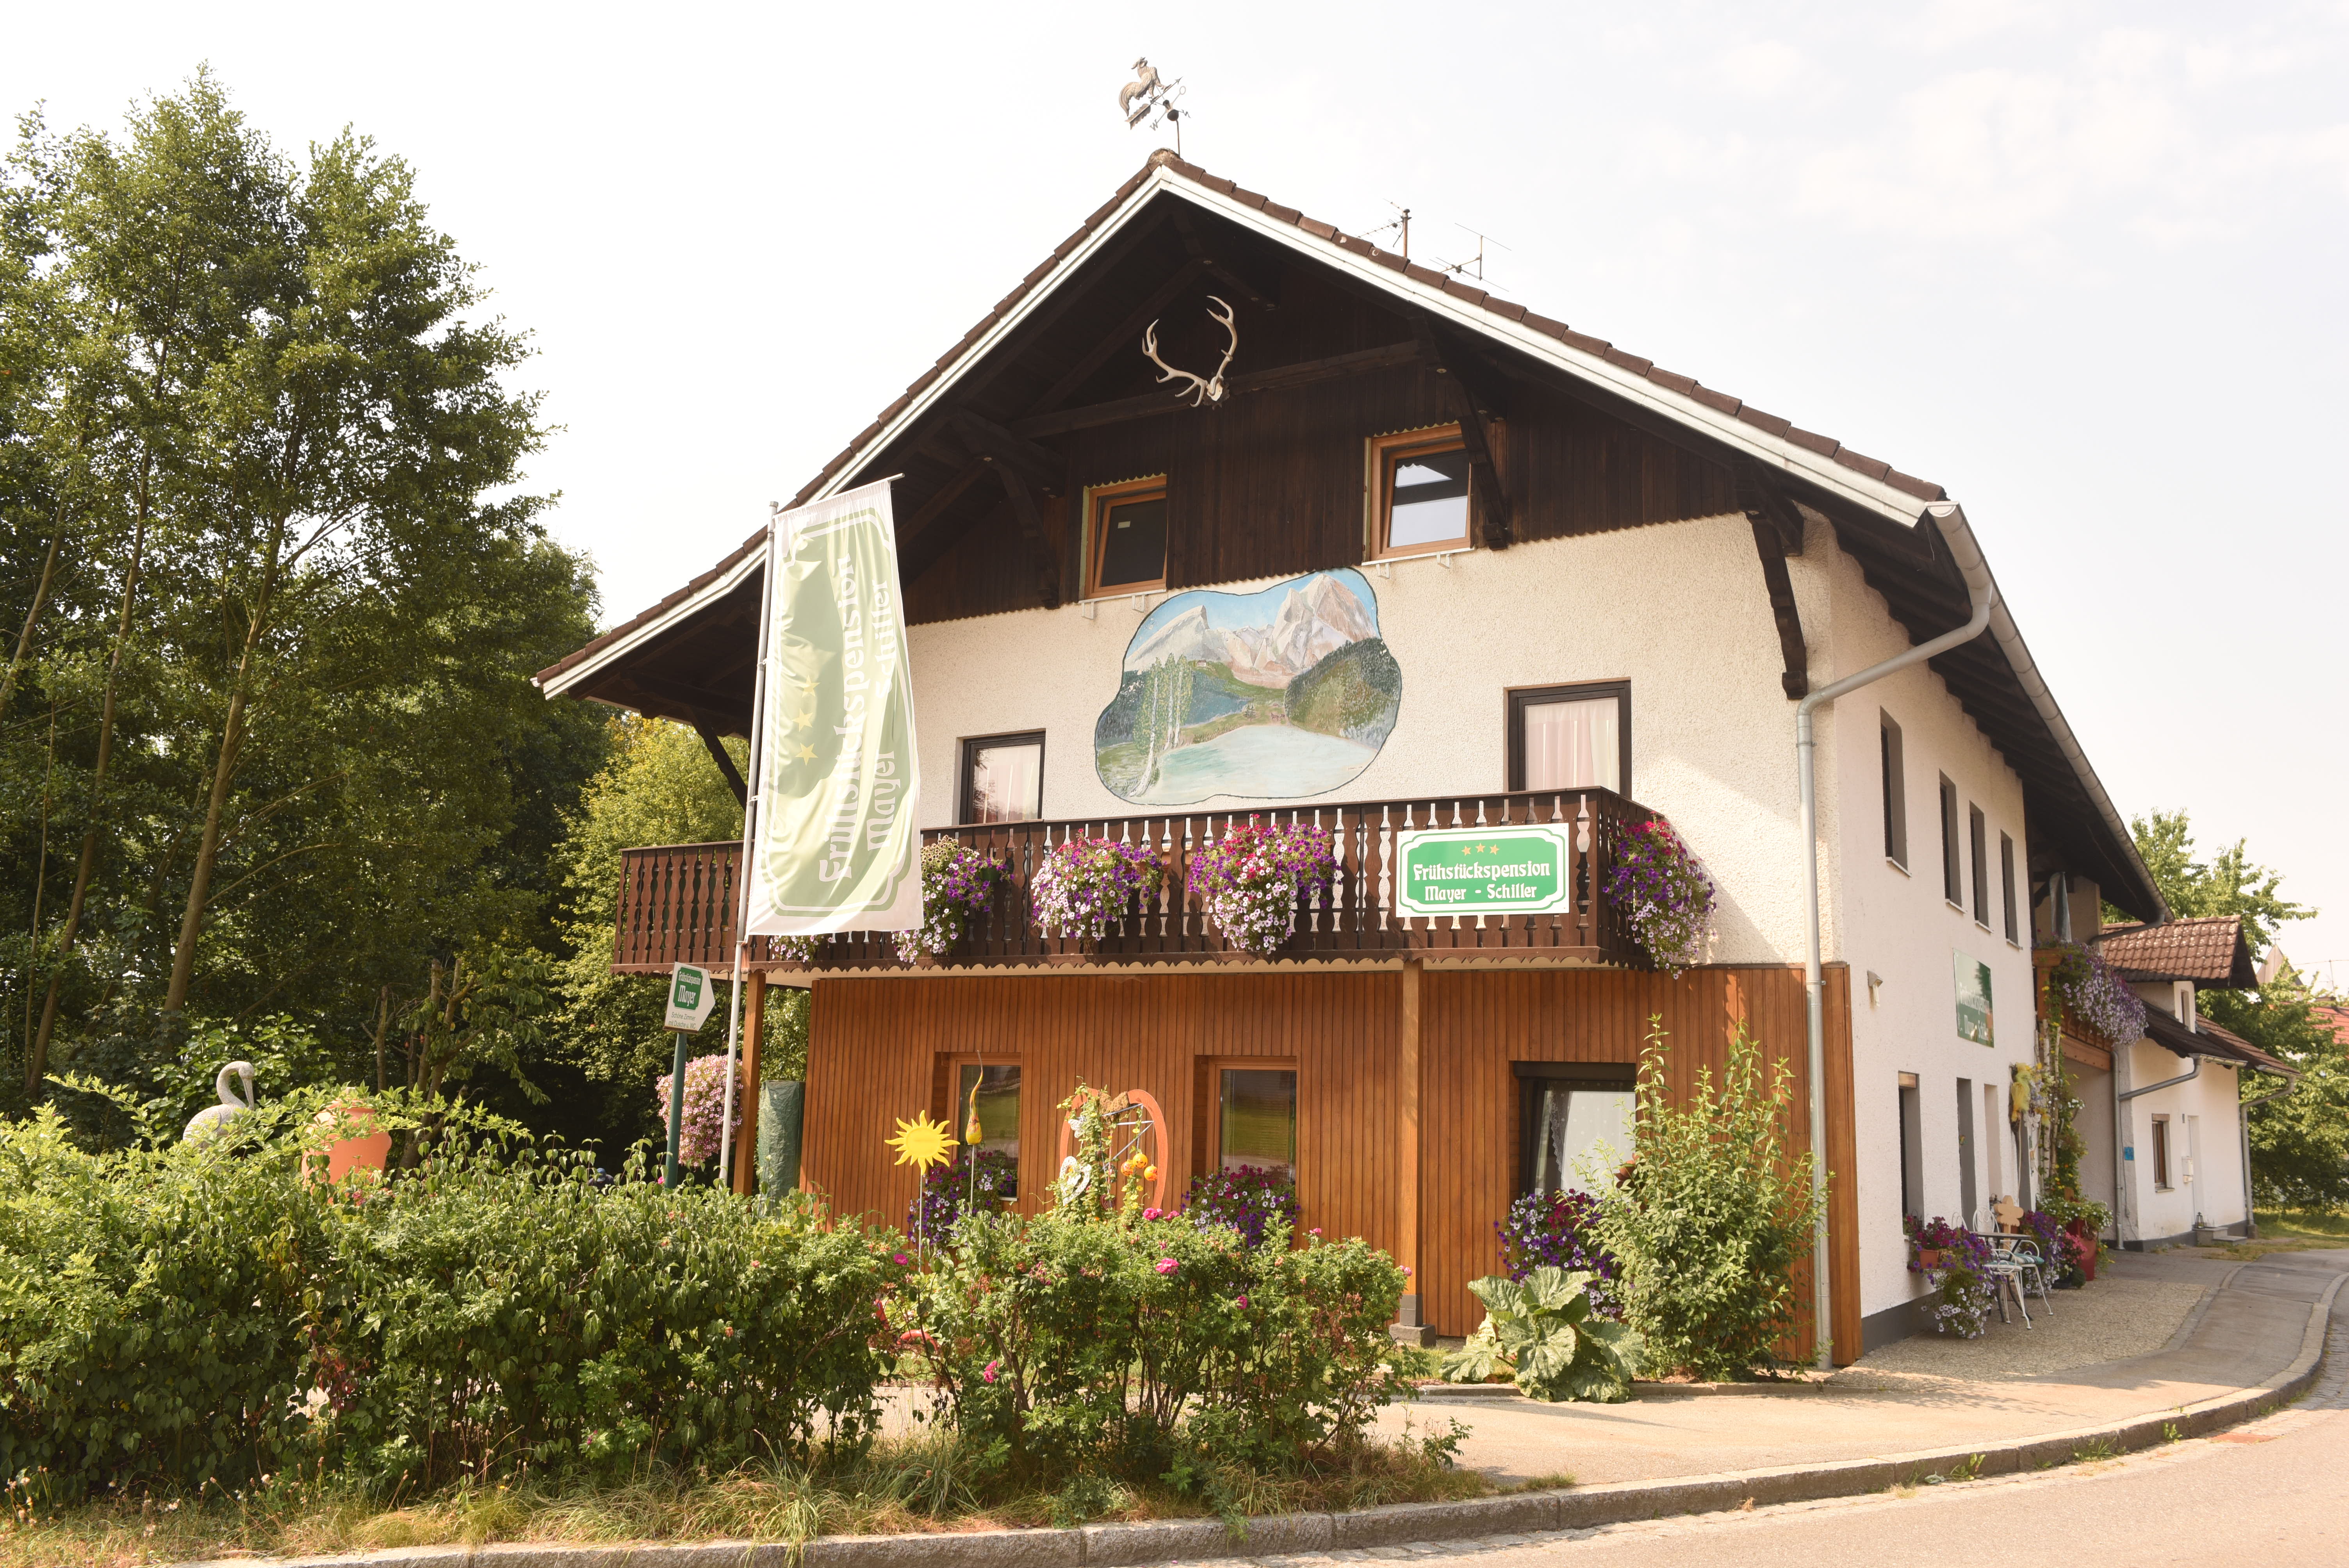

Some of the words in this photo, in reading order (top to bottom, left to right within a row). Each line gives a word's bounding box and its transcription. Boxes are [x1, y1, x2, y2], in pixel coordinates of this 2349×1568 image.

[1413, 861, 1550, 881] Frühstückspension
[1425, 886, 1467, 903] Mayer
[1487, 883, 1537, 899] Schiller
[678, 985, 696, 1007] Mayer
